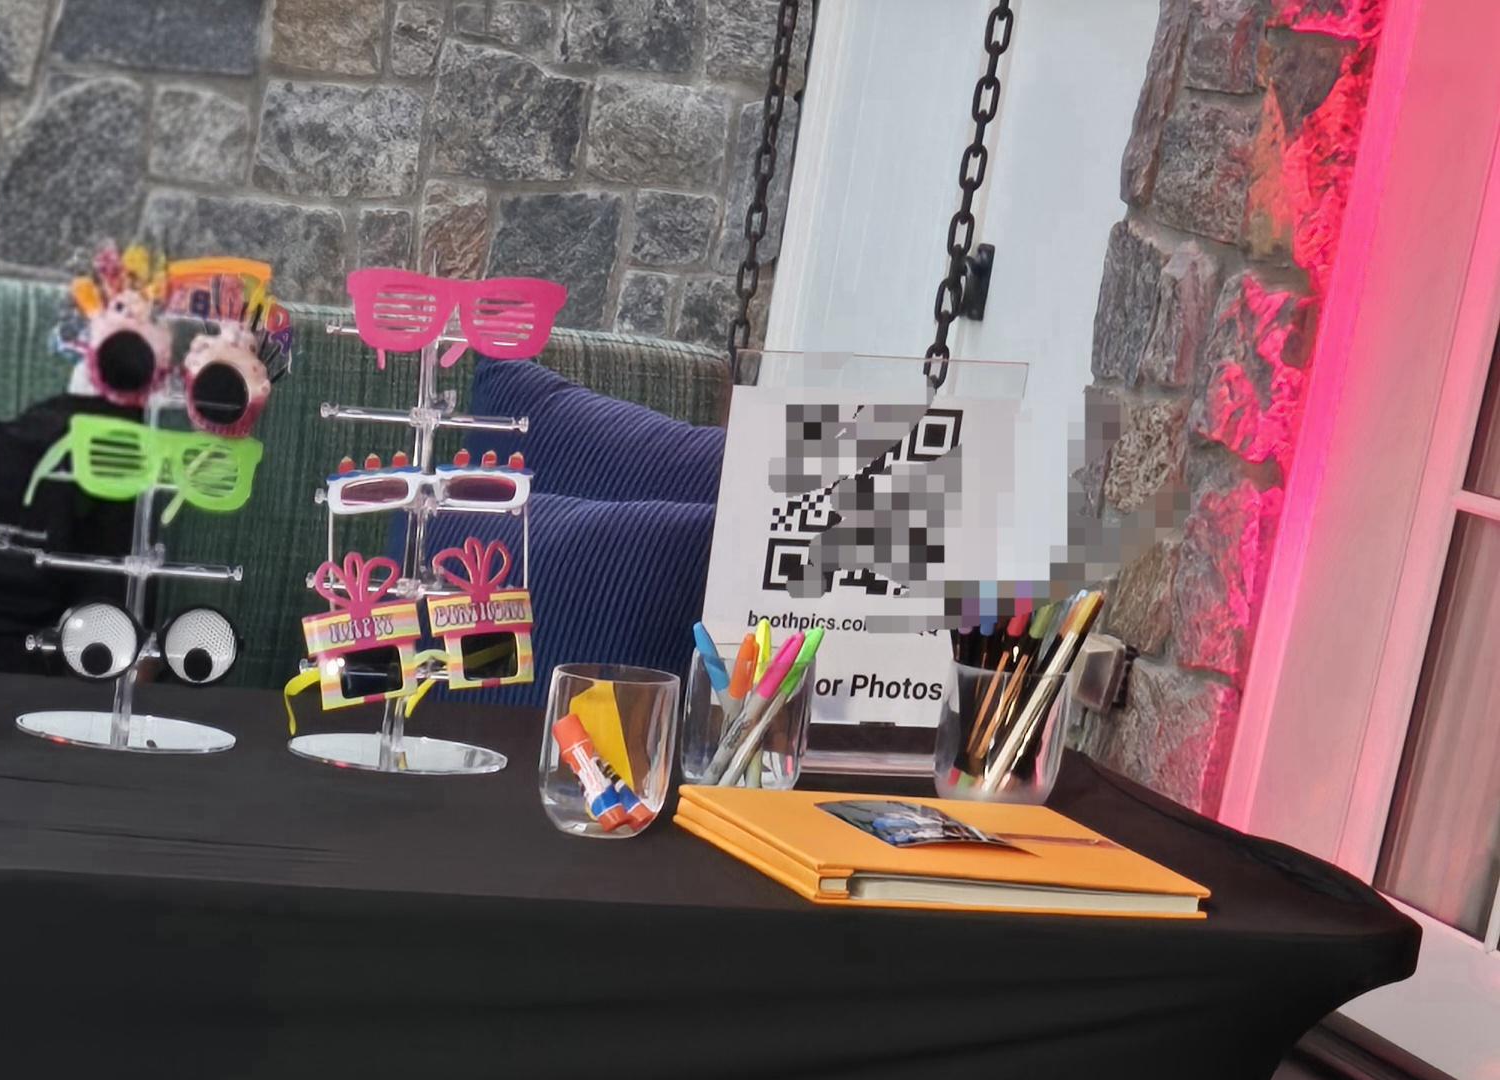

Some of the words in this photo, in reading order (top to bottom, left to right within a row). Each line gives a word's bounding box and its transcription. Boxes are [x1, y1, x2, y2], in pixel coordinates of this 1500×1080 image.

[747, 610, 867, 632] bothpics.co
[815, 678, 843, 696] or
[850, 673, 943, 700] Photos
